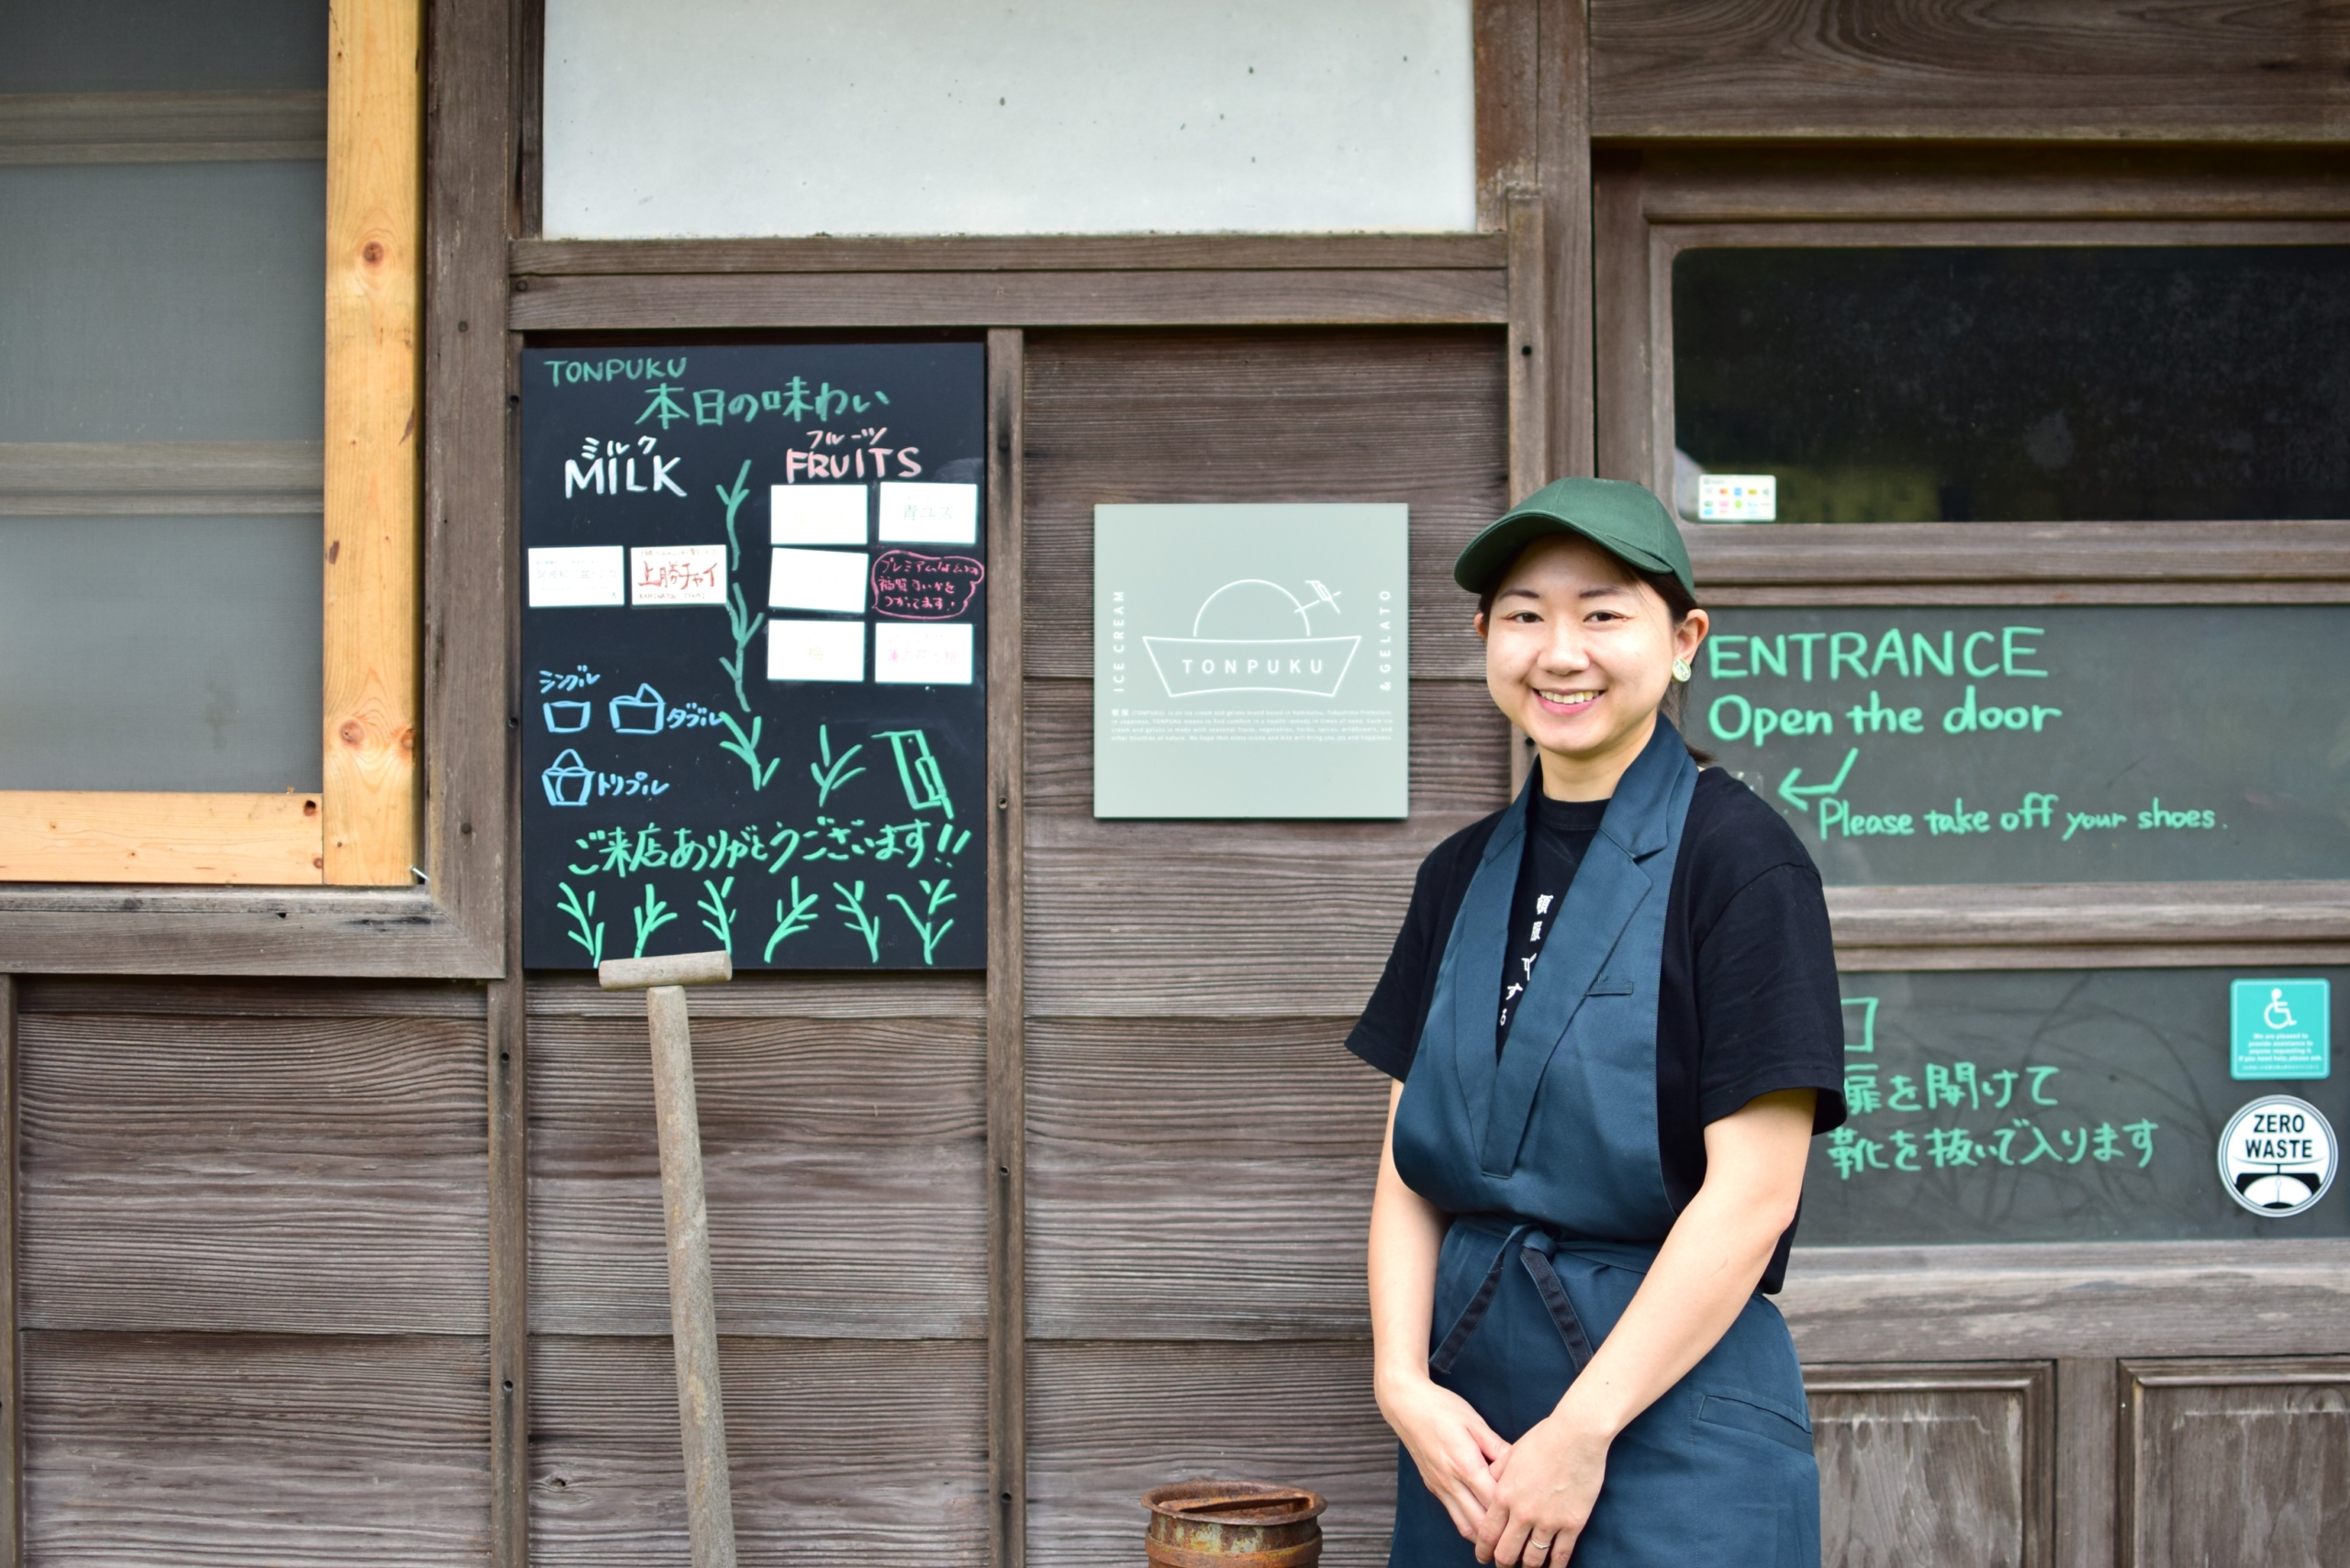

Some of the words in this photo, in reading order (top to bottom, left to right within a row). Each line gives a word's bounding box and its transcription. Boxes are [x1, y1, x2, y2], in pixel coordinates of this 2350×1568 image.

[544, 357, 688, 386] TONPUKU
[634, 376, 890, 431] 本日の味わい
[581, 435, 657, 460] ミルク
[806, 427, 888, 449] フルーツ
[565, 455, 688, 498] MILK
[786, 447, 922, 484] FRUITS
[637, 560, 718, 590] 上勝チャイ
[1113, 590, 1125, 653] CREAM
[1379, 590, 1392, 673] GELATO
[1182, 658, 1324, 675] TONPUKU
[1707, 626, 2049, 681] ENTRANCE
[539, 665, 600, 694] シングル
[1113, 662, 1125, 692] ICE
[666, 702, 725, 729] ダブル
[1707, 694, 1833, 747] Open
[1845, 690, 1924, 735] the
[1942, 685, 2063, 733] door
[599, 771, 669, 797] トリプル
[1818, 797, 1915, 841] Please
[1924, 797, 1990, 835] take
[2001, 791, 2059, 828] off
[2062, 810, 2128, 842] your
[1843, 1061, 2061, 1115] 扉を開けて
[2253, 1114, 2305, 1134] ZERO
[1827, 1117, 2160, 1181] 靴を抜いで入ります
[2245, 1139, 2313, 1159] WASTE
